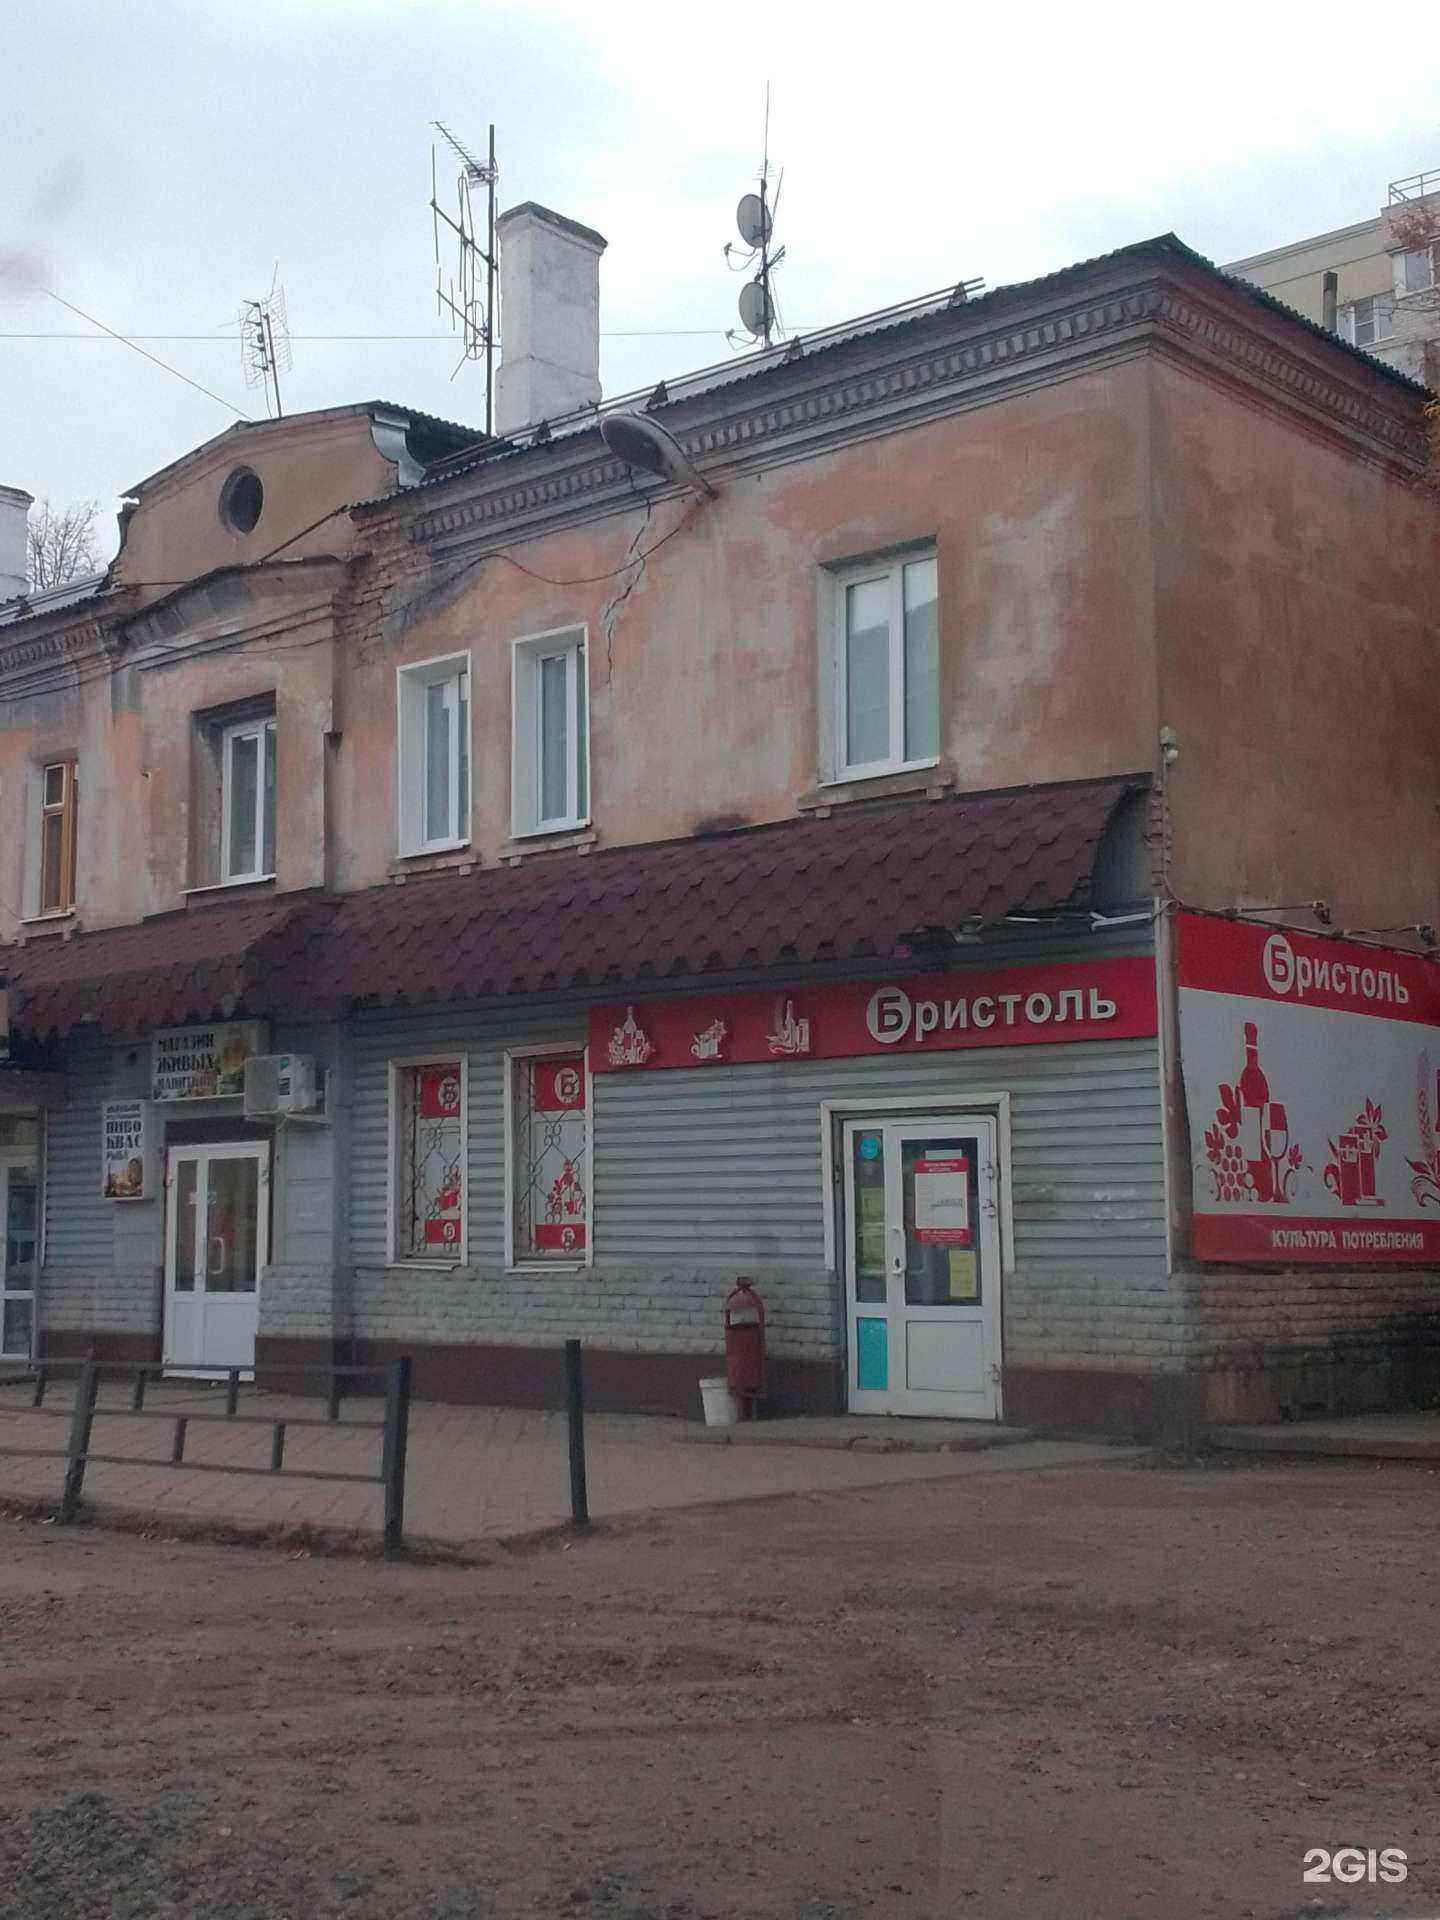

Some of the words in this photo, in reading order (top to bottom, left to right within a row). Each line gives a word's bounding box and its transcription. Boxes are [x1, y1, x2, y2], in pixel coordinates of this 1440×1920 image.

[1263, 934, 1409, 1004] Бристоль
[866, 987, 1116, 1043] Бристоль
[107, 1134, 141, 1149] КВАС
[1272, 1230, 1336, 1249] КУЛЬТУРА
[1342, 1231, 1424, 1249] ПОТРЕБЛЕНИЯ
